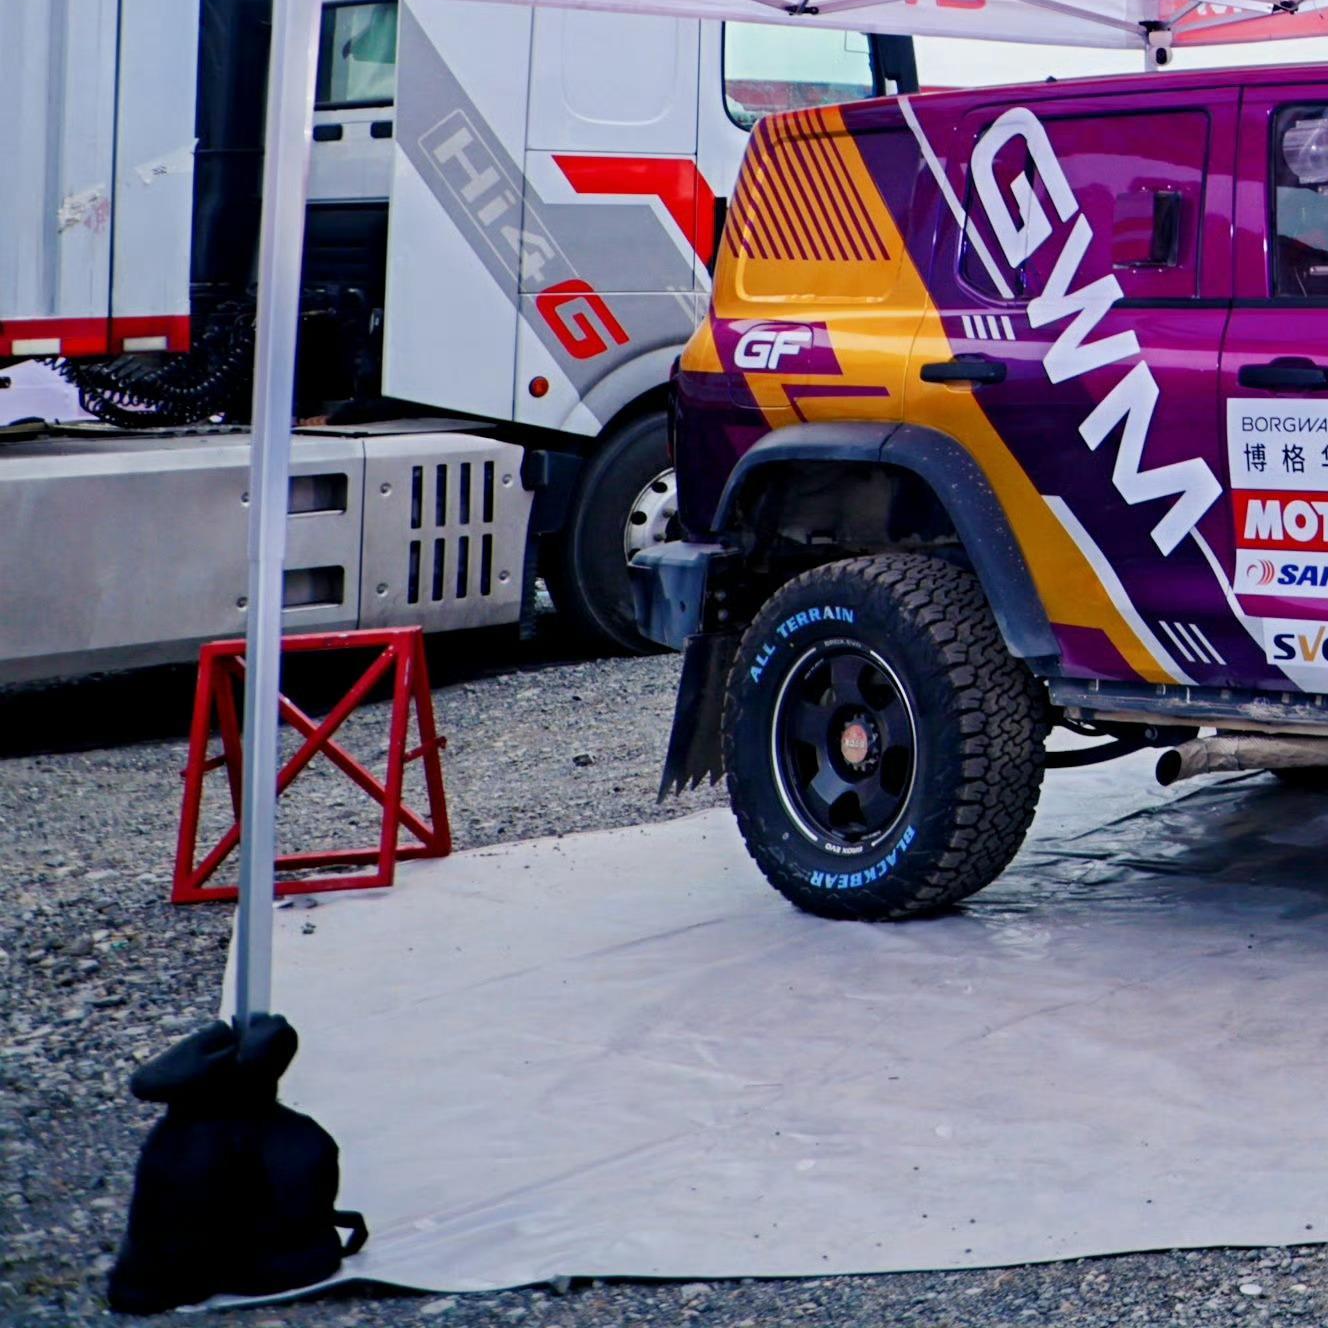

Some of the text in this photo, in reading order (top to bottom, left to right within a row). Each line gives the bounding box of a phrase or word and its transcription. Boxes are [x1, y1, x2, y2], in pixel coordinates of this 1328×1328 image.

[734, 330, 811, 370] GF
[970, 106, 1223, 557] GWM
[749, 642, 776, 684] ALL
[776, 605, 856, 641] TERRAIN
[810, 824, 916, 889] BLACKBEAR
